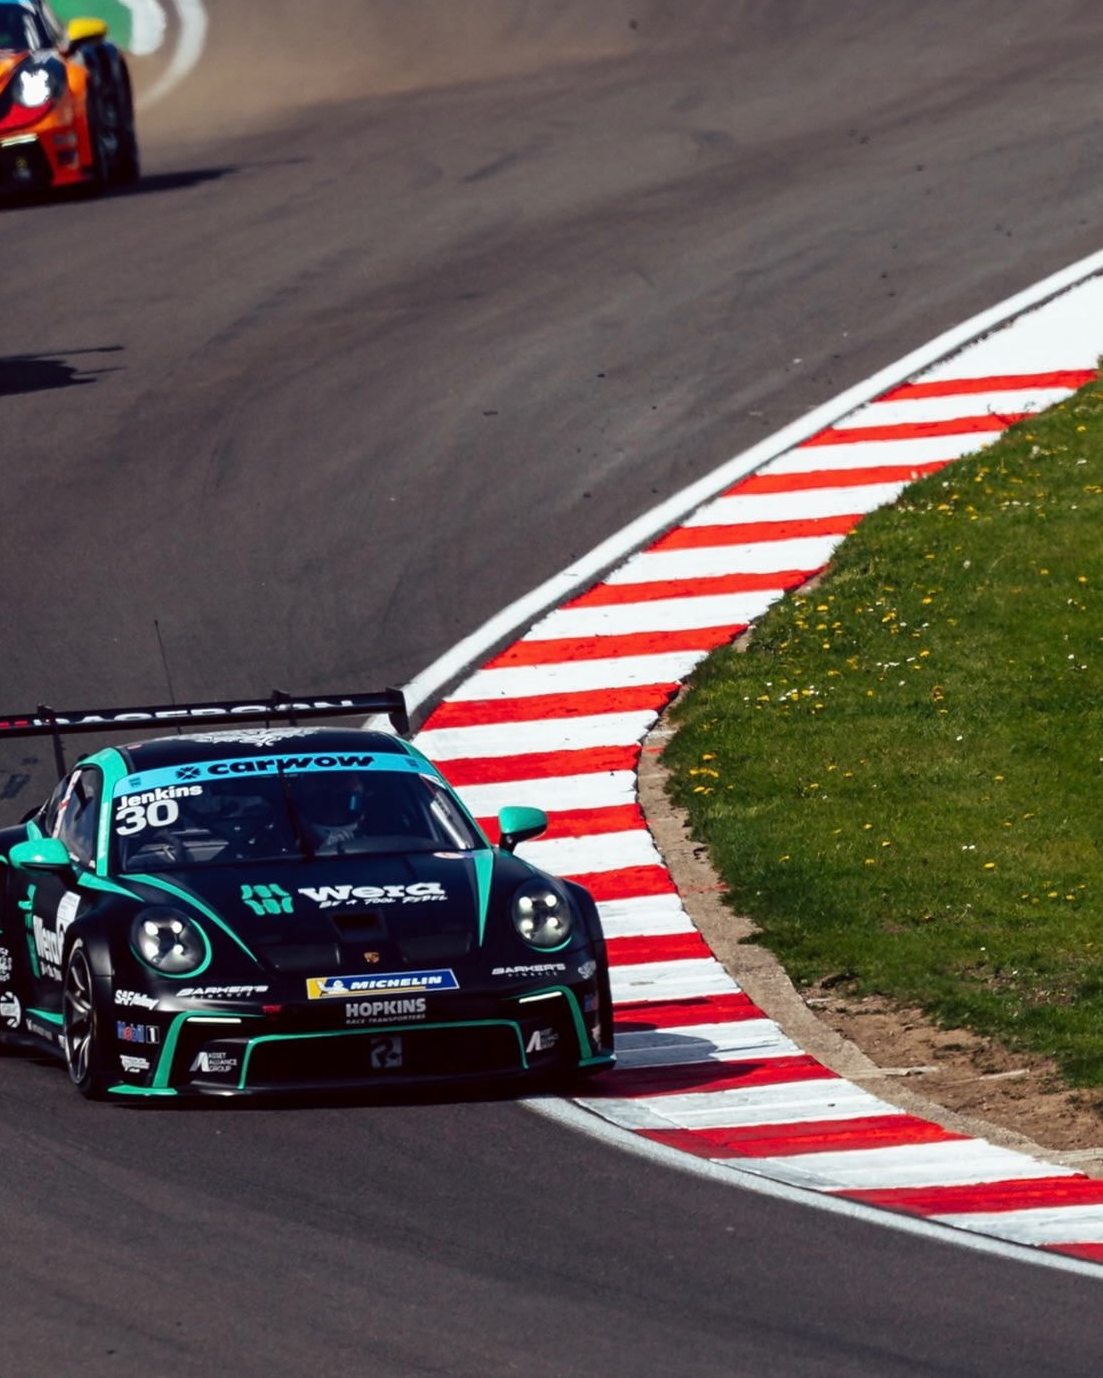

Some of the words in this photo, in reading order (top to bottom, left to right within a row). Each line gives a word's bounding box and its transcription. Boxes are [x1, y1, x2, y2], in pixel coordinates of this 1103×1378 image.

[207, 755, 374, 775] carwow
[117, 785, 203, 811] Jenkins
[115, 799, 178, 836] 30
[298, 882, 446, 902] Wera
[350, 976, 442, 990] MICHELIN
[345, 998, 427, 1018] HOPKINS
